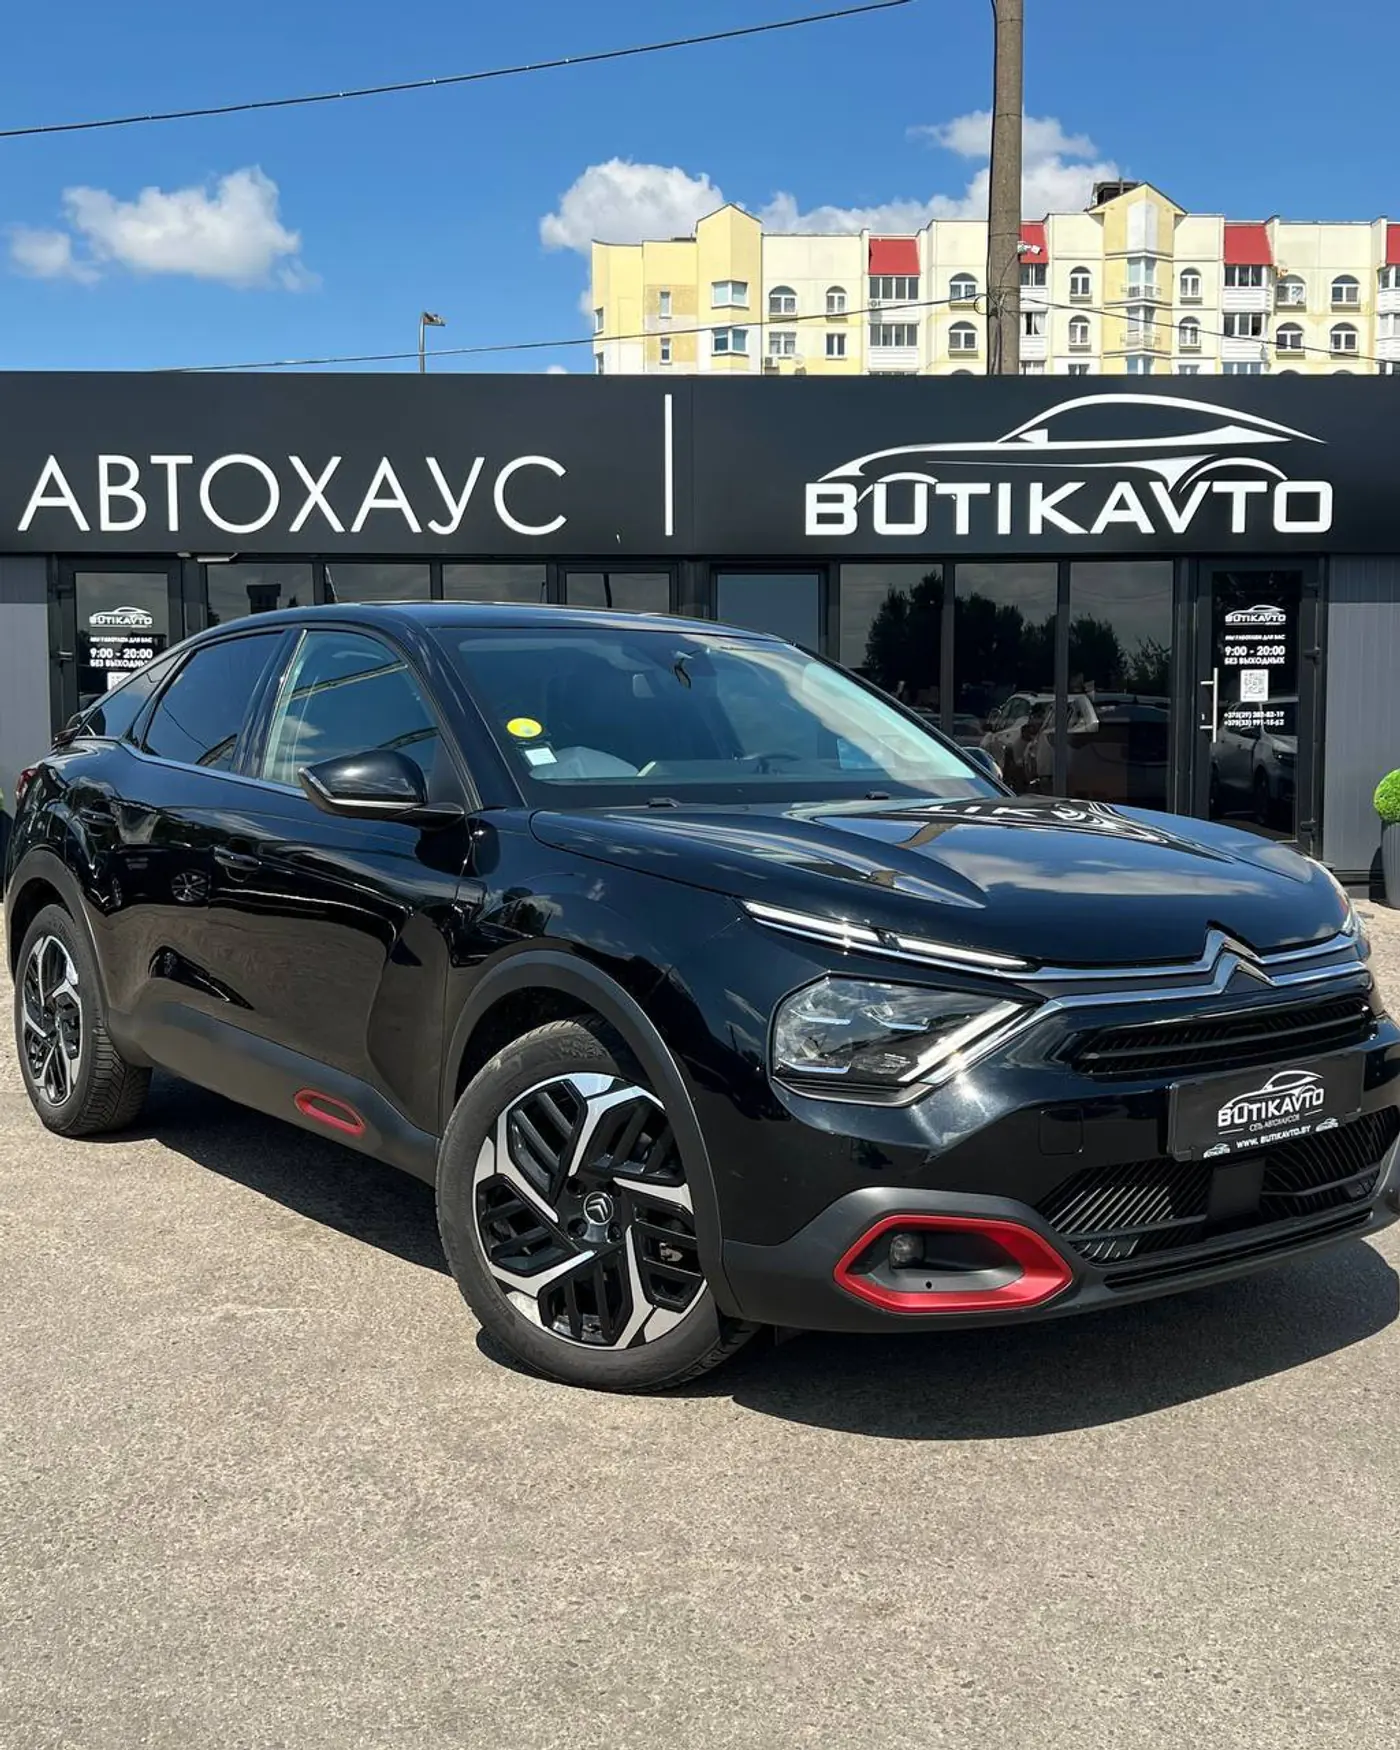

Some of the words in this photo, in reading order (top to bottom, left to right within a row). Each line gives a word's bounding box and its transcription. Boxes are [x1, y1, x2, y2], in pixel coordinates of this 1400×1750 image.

[18, 454, 567, 536] АВТОХАУС
[805, 481, 1333, 535] BUTIKAVTO
[90, 648, 113, 659] 9:00
[123, 648, 153, 659] 20:00
[1225, 646, 1247, 656] 9:00
[1257, 646, 1285, 656] 20:00
[1218, 1089, 1324, 1127] BUTIKAVTO
[1260, 1125, 1311, 1144] BUTIKAVTO.BY
